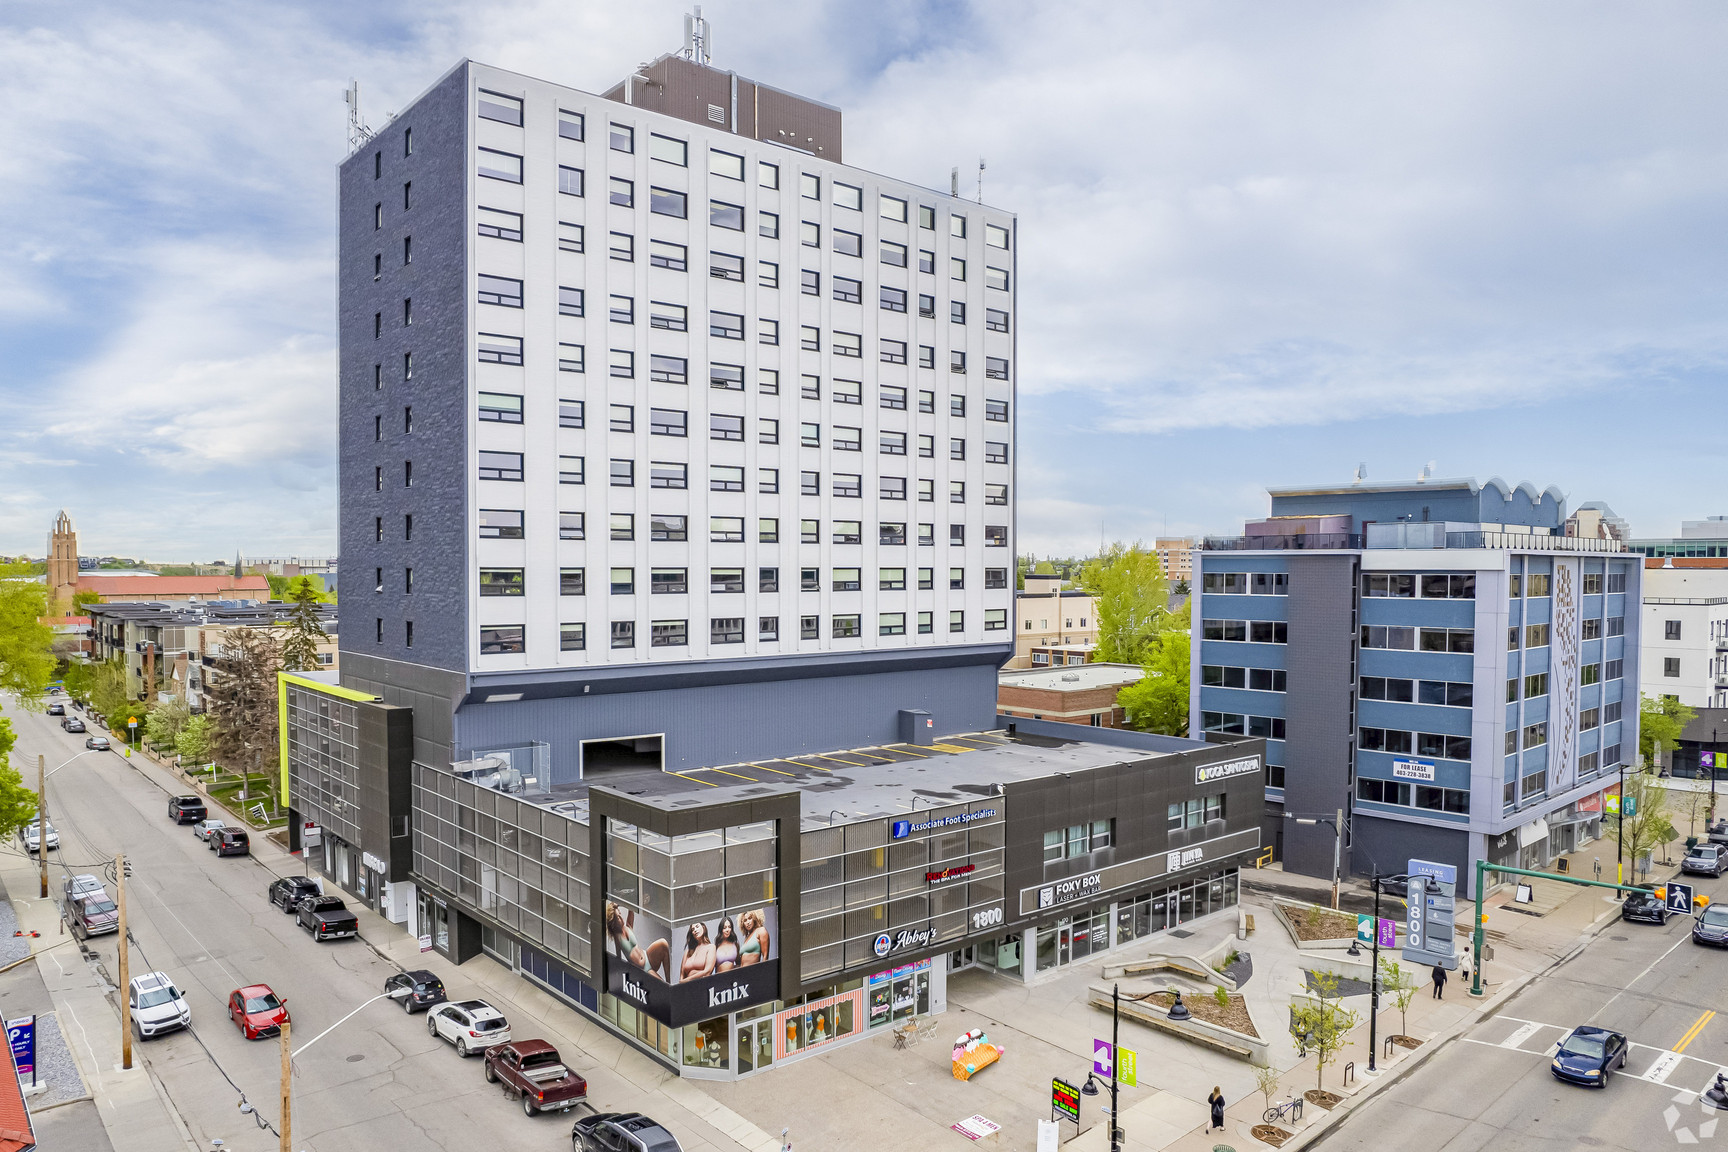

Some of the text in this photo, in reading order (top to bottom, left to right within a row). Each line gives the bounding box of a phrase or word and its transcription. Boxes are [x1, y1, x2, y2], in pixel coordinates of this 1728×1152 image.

[1206, 766, 1225, 779] YOGA
[910, 808, 997, 833] Associate Foot Specialists
[1418, 867, 1444, 875] LEASING
[1056, 873, 1101, 895] FOXY BOX
[1056, 886, 1102, 904] LASER WAX BAR
[973, 907, 1003, 929] 1800
[1410, 892, 1421, 946] 1800
[892, 927, 937, 950] Abbey's
[622, 973, 648, 1005] knix
[708, 981, 750, 1008] knix
[10, 1029, 20, 1041] P
